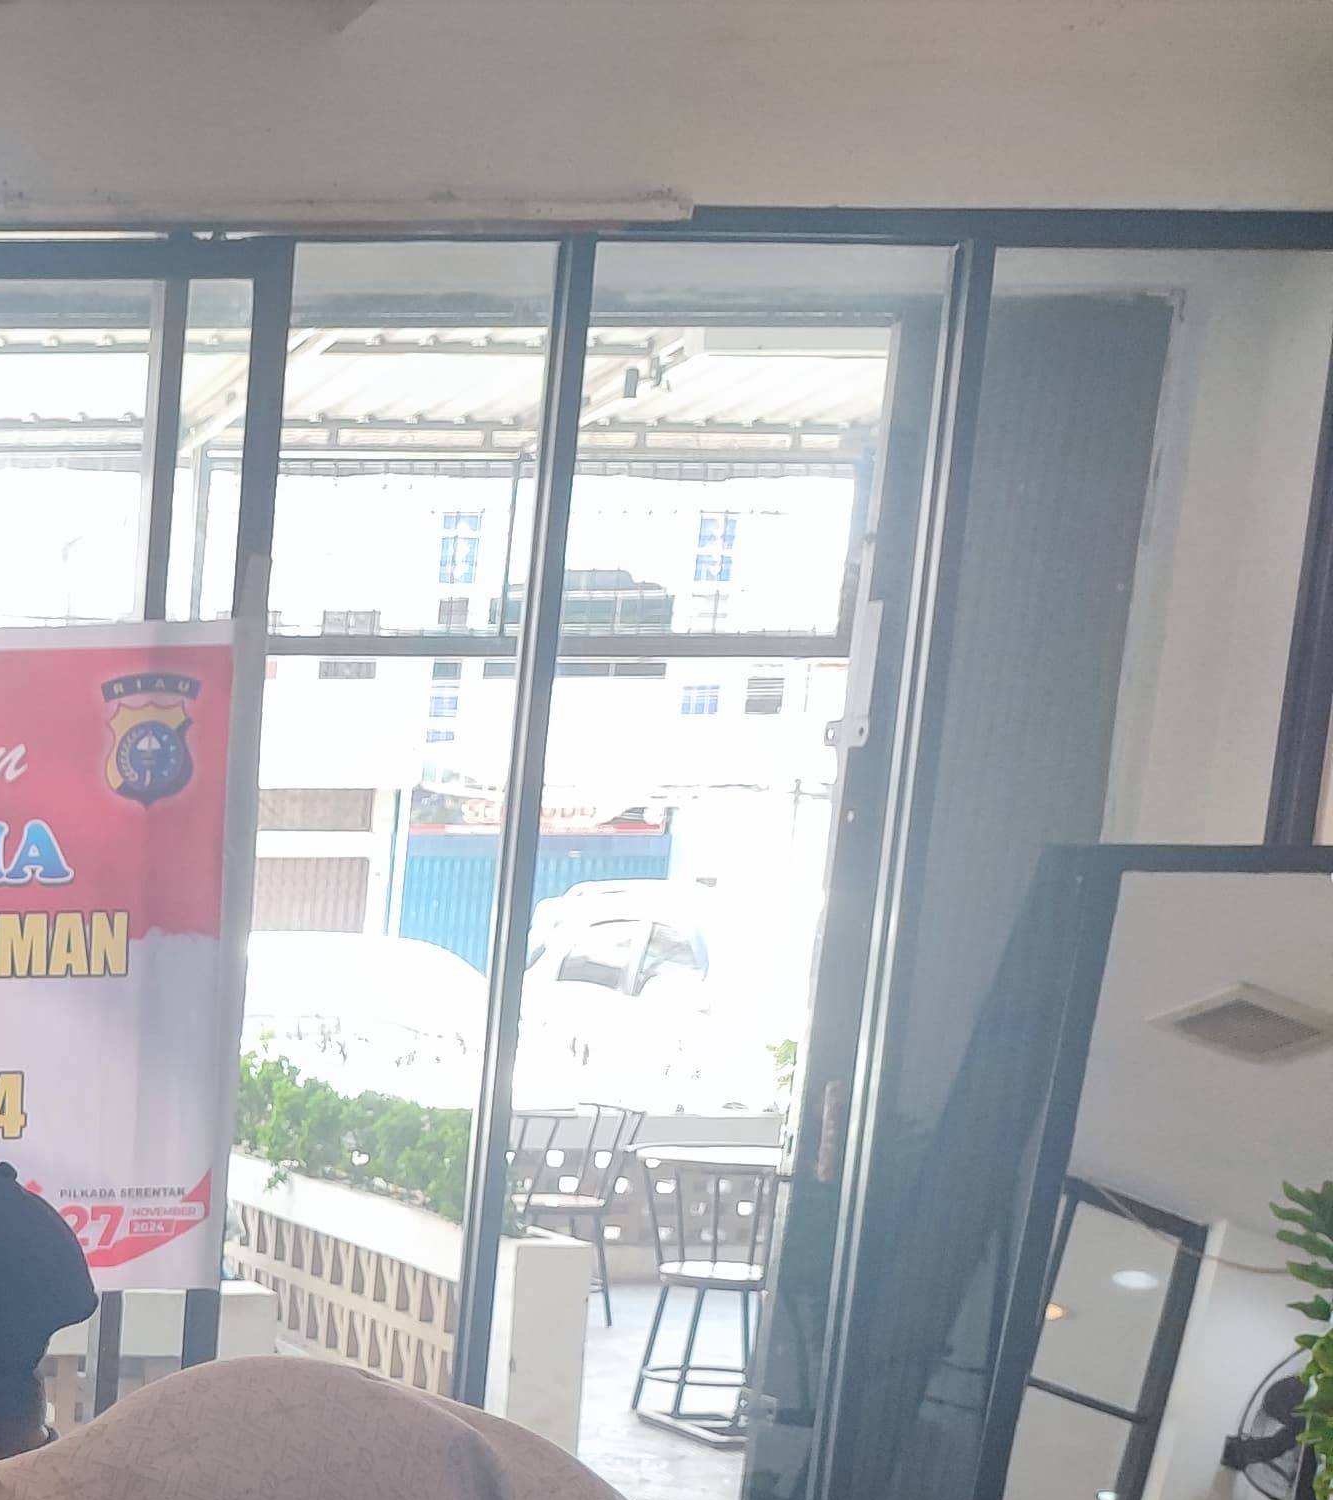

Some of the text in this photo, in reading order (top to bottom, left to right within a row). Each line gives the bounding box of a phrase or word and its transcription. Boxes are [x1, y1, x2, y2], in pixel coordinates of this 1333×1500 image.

[113, 679, 190, 695] RIAU
[60, 1186, 186, 1199] PILKADA SERENTAK
[59, 1204, 197, 1247] 27 NOVEMBER
[132, 1221, 166, 1232] 2024
